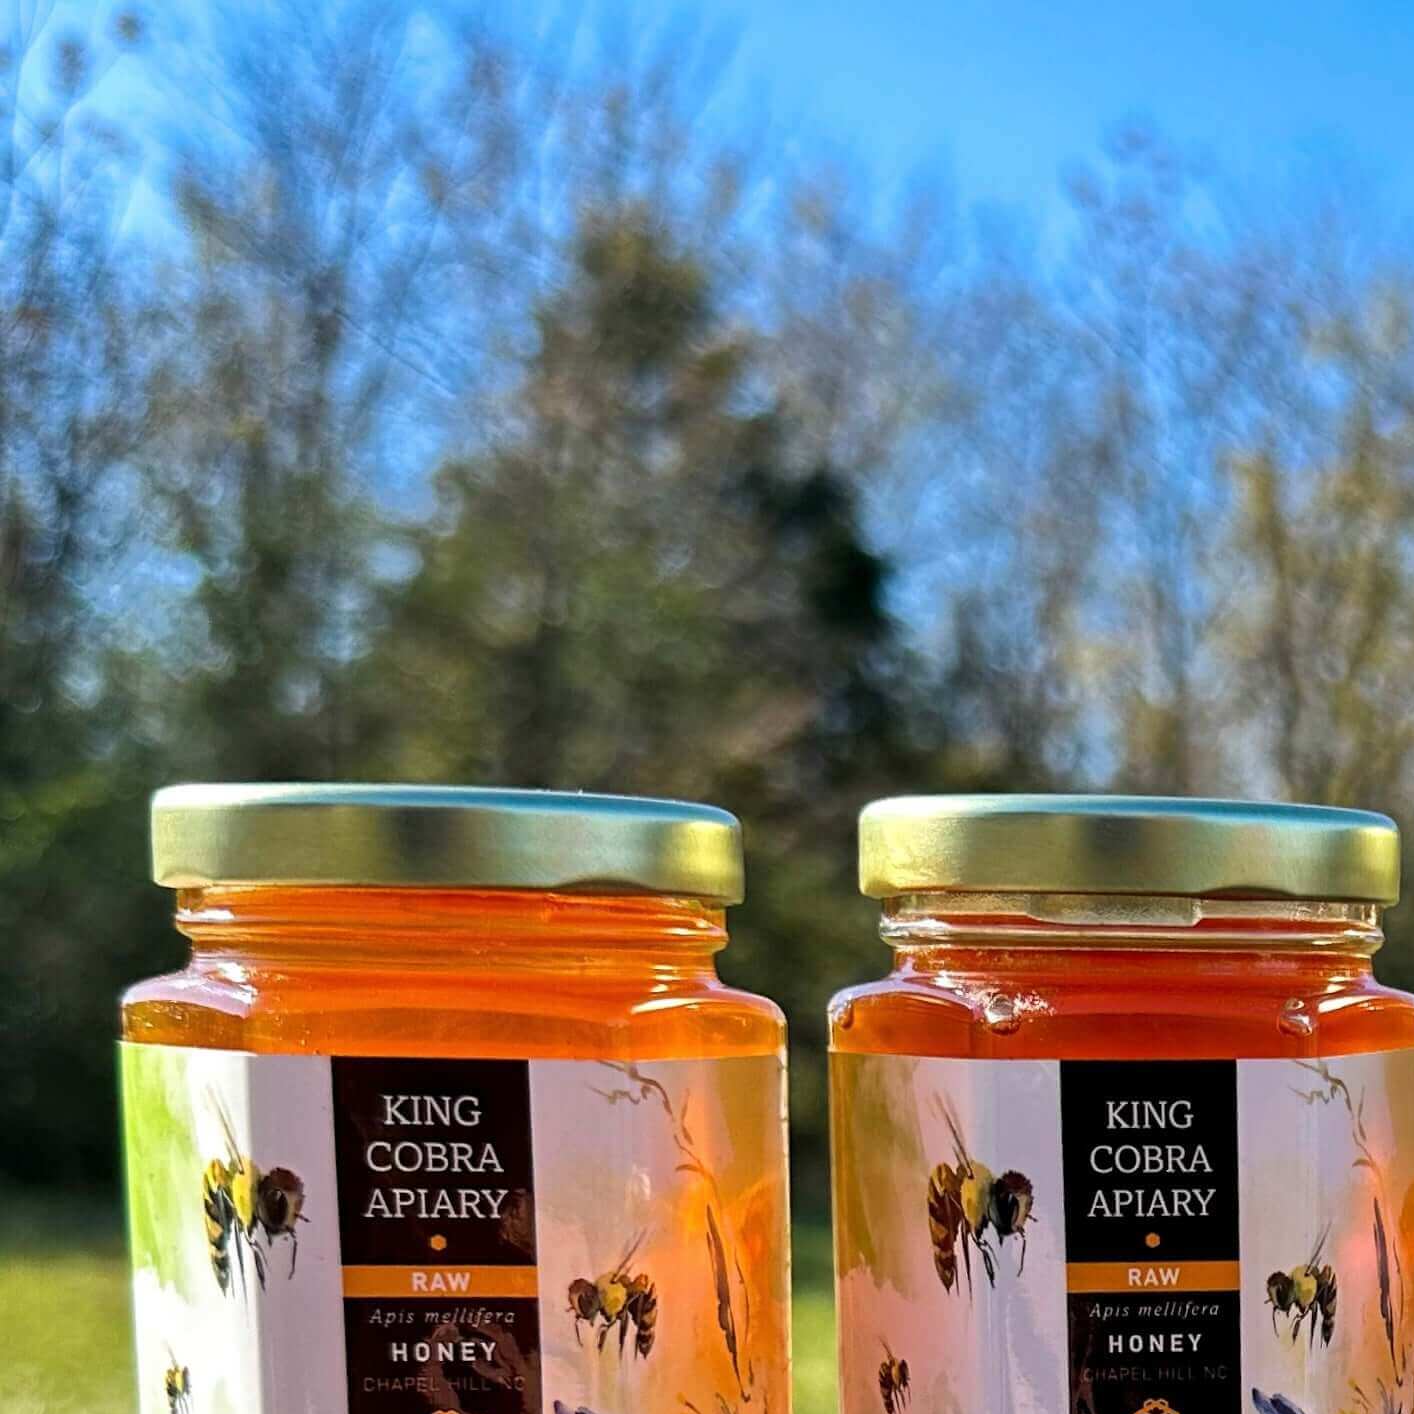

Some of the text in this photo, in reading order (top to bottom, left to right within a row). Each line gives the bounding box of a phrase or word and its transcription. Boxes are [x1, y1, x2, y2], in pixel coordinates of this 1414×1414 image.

[383, 1095, 482, 1126] KING
[1106, 1100, 1195, 1130] KING
[366, 1142, 504, 1173] COBRA
[1089, 1144, 1213, 1174] COBRA
[363, 1189, 509, 1218] APIARY
[1087, 1189, 1216, 1217] APIARY
[412, 1272, 470, 1291] RAW
[1128, 1268, 1180, 1286] RAW
[369, 1307, 515, 1328] Apis mellifera
[1089, 1301, 1219, 1320] Apis mellifera
[391, 1342, 496, 1362] HONEY
[1109, 1333, 1202, 1353] HONEY
[1083, 1365, 1227, 1382] CHAPEL HILL NC
[363, 1377, 440, 1392] CHAPEL
